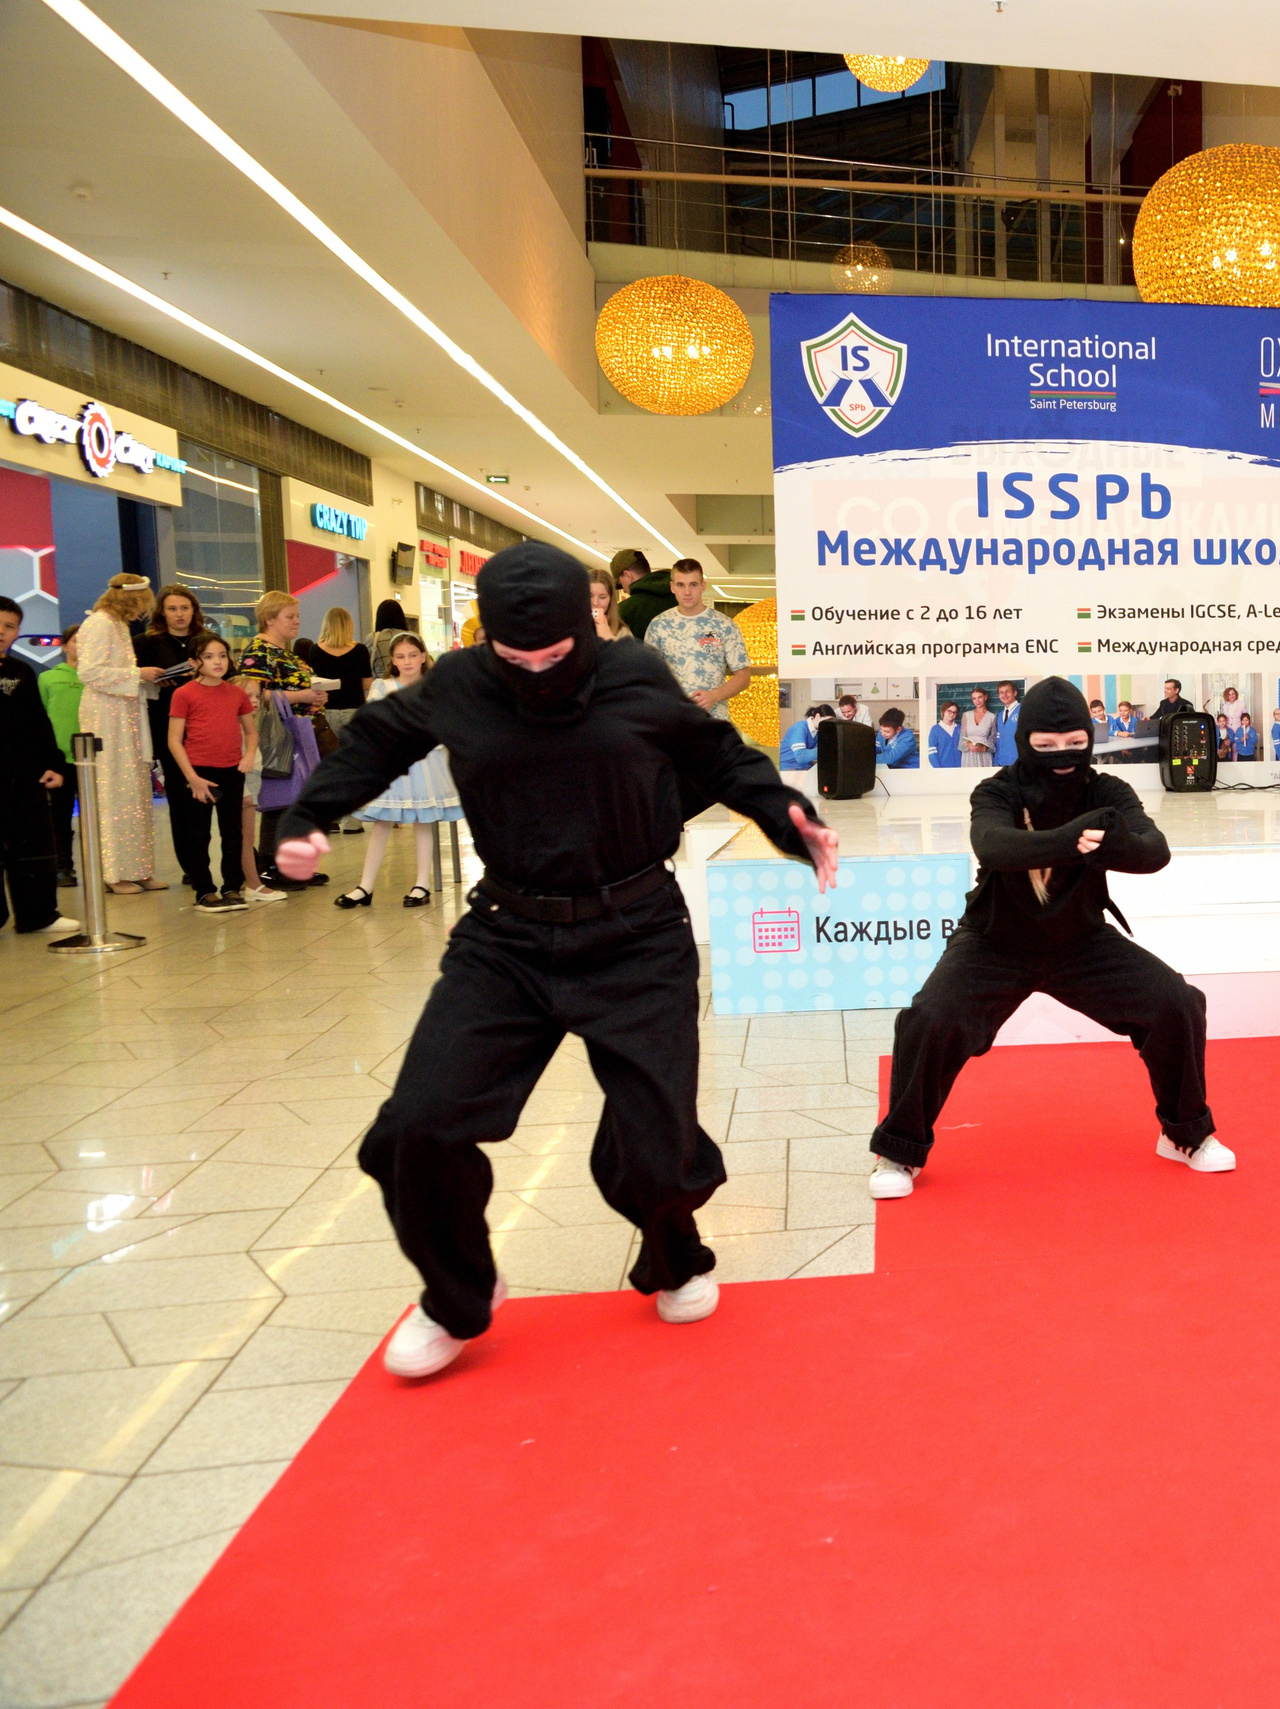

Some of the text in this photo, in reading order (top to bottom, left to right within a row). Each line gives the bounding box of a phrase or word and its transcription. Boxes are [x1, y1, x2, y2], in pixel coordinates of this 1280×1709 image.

[986, 333, 1156, 361] International
[840, 345, 871, 372] IS
[1028, 362, 1117, 388] School
[848, 403, 866, 412] SPb
[1029, 398, 1117, 413] Saint Petersburg
[314, 502, 368, 541] CRAZY ТИР
[816, 529, 1179, 575] Международная
[811, 605, 1023, 624] Обучение с 2 до 16 лет
[1097, 604, 1185, 619] Экзамены
[1190, 604, 1241, 620] IGCSE,
[811, 639, 1059, 658] Английская программа ENC
[1097, 638, 1243, 656] Международная
[815, 915, 932, 946] Каждые
